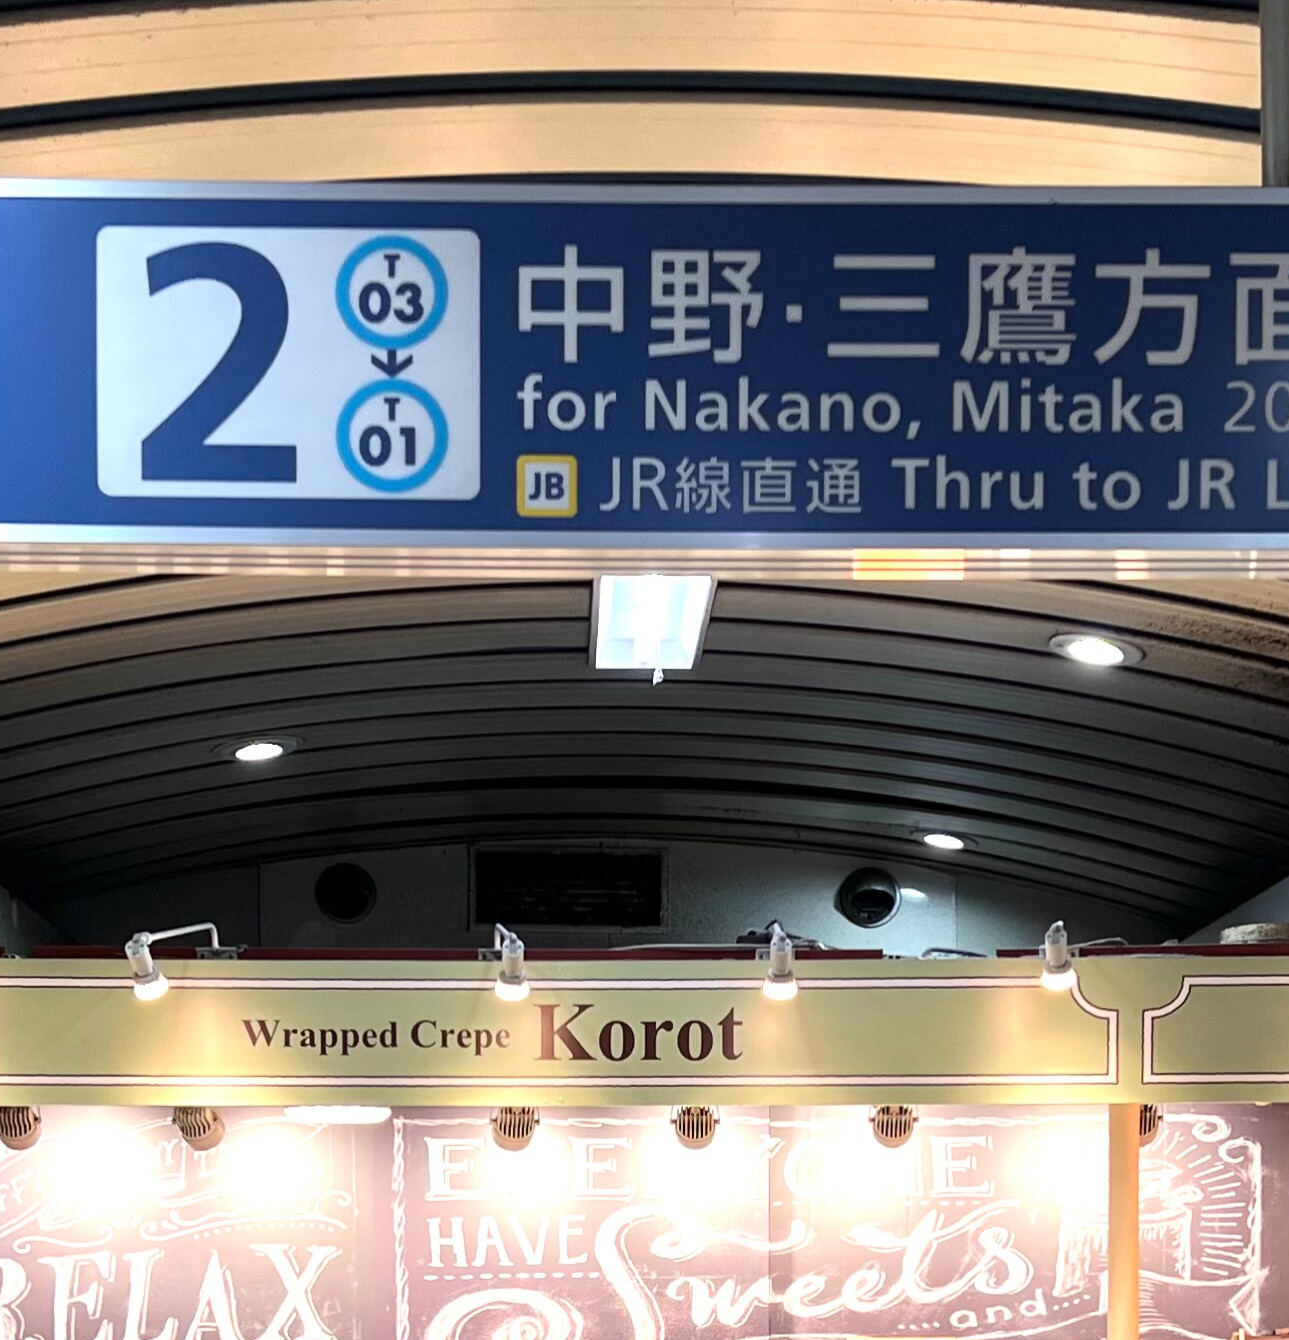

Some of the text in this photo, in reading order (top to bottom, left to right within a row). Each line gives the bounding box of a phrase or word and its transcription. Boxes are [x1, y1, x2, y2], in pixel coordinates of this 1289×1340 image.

[383, 254, 399, 278] T
[358, 282, 423, 324] 03
[141, 241, 297, 483] 2
[383, 397, 400, 421] T
[518, 374, 616, 431] for
[644, 375, 921, 440] Nakano,
[952, 377, 1185, 433] Mitaka
[358, 425, 417, 467] 01
[528, 472, 564, 500] JB
[599, 455, 862, 515] JR線直通
[891, 456, 1044, 510] Thru
[1073, 462, 1141, 511] to
[1167, 458, 1236, 511] JR
[241, 1003, 744, 1061] Wrapped Crepe Korot
[427, 1214, 590, 1268] HAVE
[949, 1288, 1047, 1329] and
